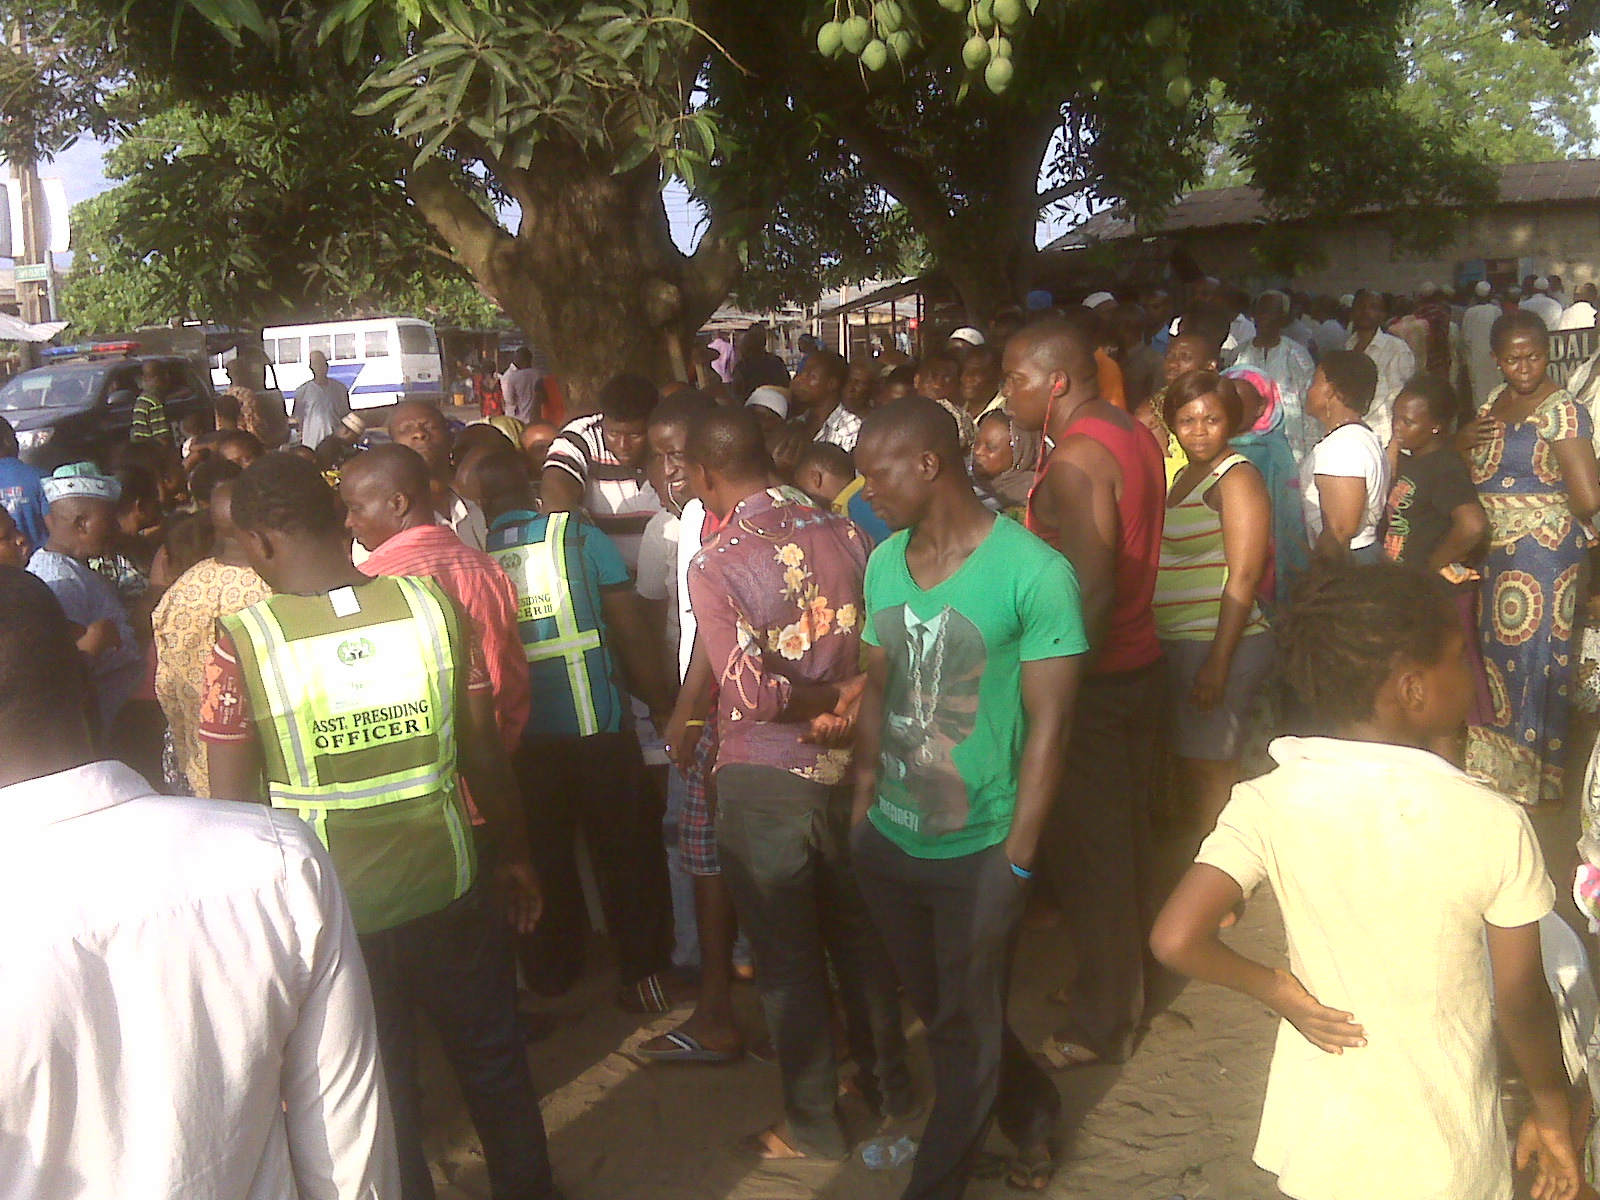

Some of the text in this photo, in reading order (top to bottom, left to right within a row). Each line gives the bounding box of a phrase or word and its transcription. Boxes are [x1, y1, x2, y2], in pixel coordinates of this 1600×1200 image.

[313, 716, 348, 734] ASST.
[353, 699, 429, 728] PRESIDING
[315, 719, 420, 749] OFFICER
